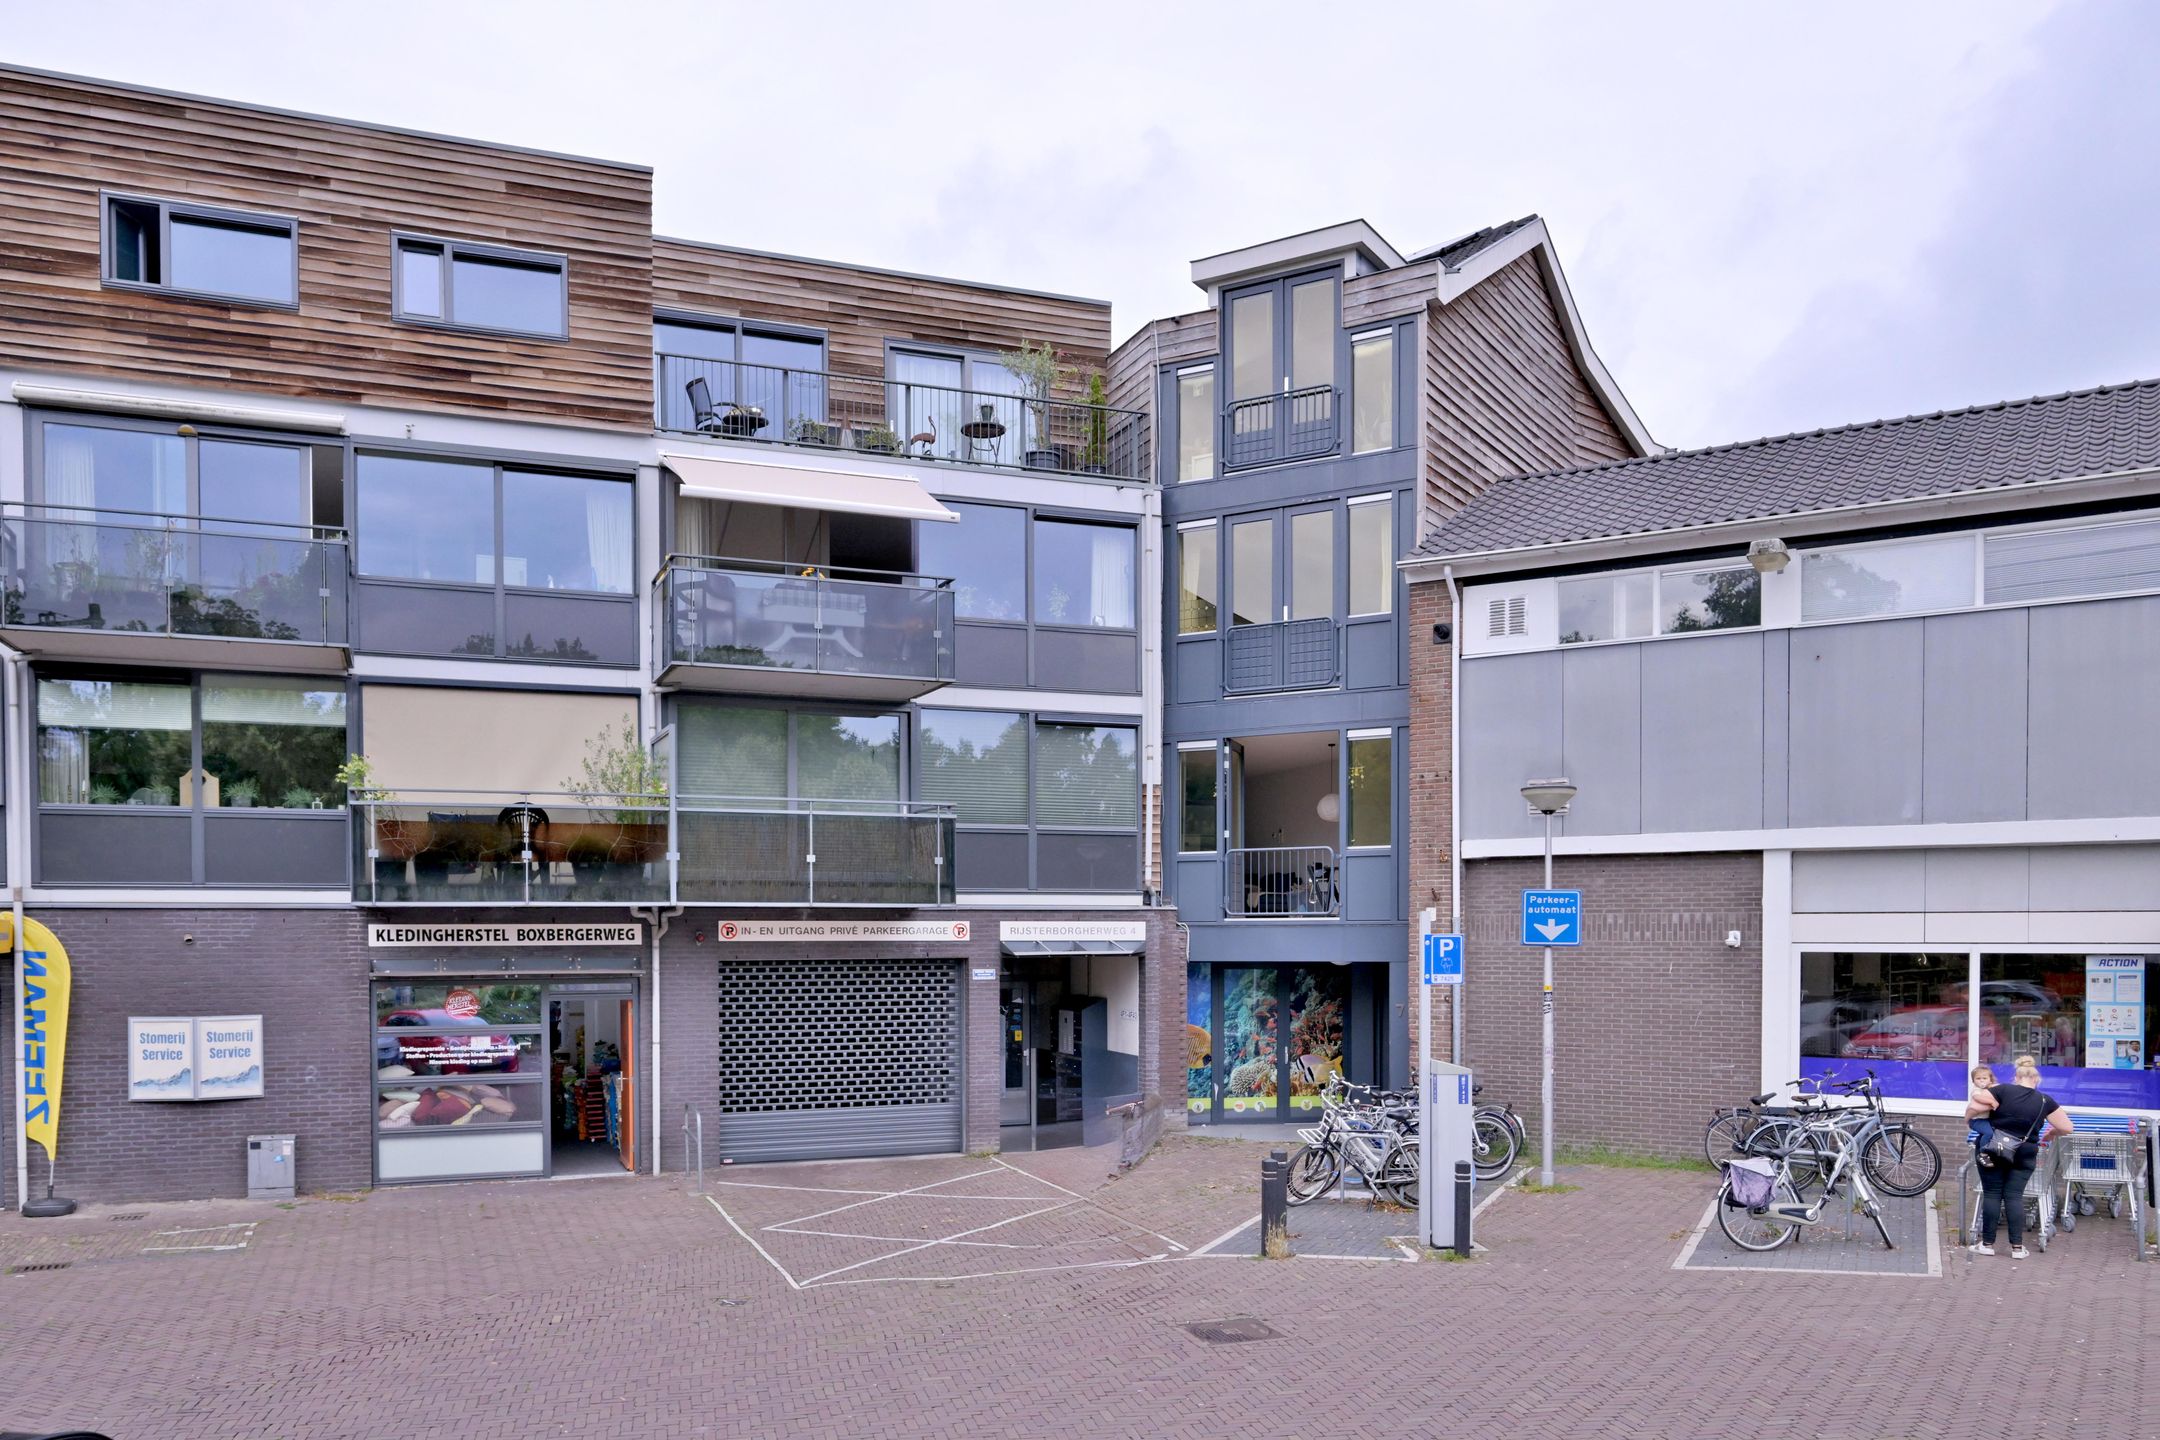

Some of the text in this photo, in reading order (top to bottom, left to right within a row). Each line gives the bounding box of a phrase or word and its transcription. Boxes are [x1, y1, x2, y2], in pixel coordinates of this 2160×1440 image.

[1530, 896, 1575, 904] Parkeer-
[1528, 906, 1577, 914] automaat
[376, 928, 636, 942] KLEDINGHERSTEL BOXBERGERWEG
[759, 927, 774, 936] EN
[779, 927, 825, 936] UITGANG
[830, 925, 858, 936] PRIVÉ
[863, 926, 949, 936] PARKEERGARAGE
[1010, 926, 1137, 935] RIJSTERBORGHERWEG 4
[1440, 939, 1455, 957] P
[2099, 959, 2139, 967] ACTION
[1395, 1003, 1405, 1018] 7
[140, 1032, 186, 1045] Stomerij
[206, 1030, 253, 1043] Stomerij
[142, 1048, 183, 1061] Service
[209, 1046, 251, 1059] Service
